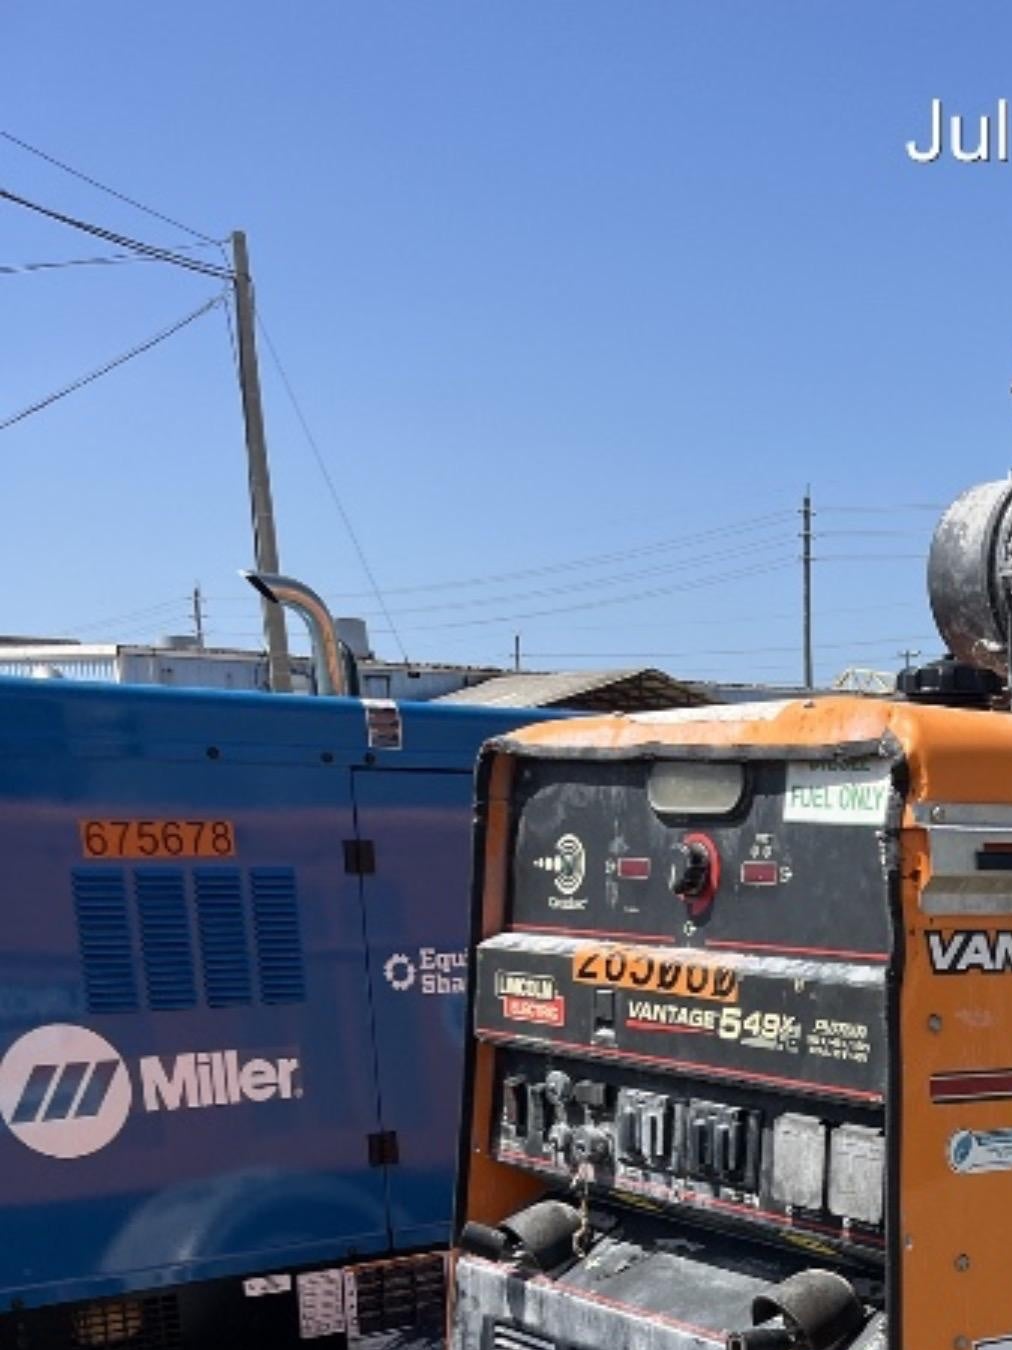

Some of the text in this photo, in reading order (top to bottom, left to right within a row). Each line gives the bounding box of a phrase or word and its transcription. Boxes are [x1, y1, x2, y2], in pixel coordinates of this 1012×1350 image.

[791, 782, 886, 811] FUEL ONLY
[84, 821, 233, 856] 675678
[628, 1001, 717, 1031] VANTAGE
[139, 1049, 300, 1113] Miller
